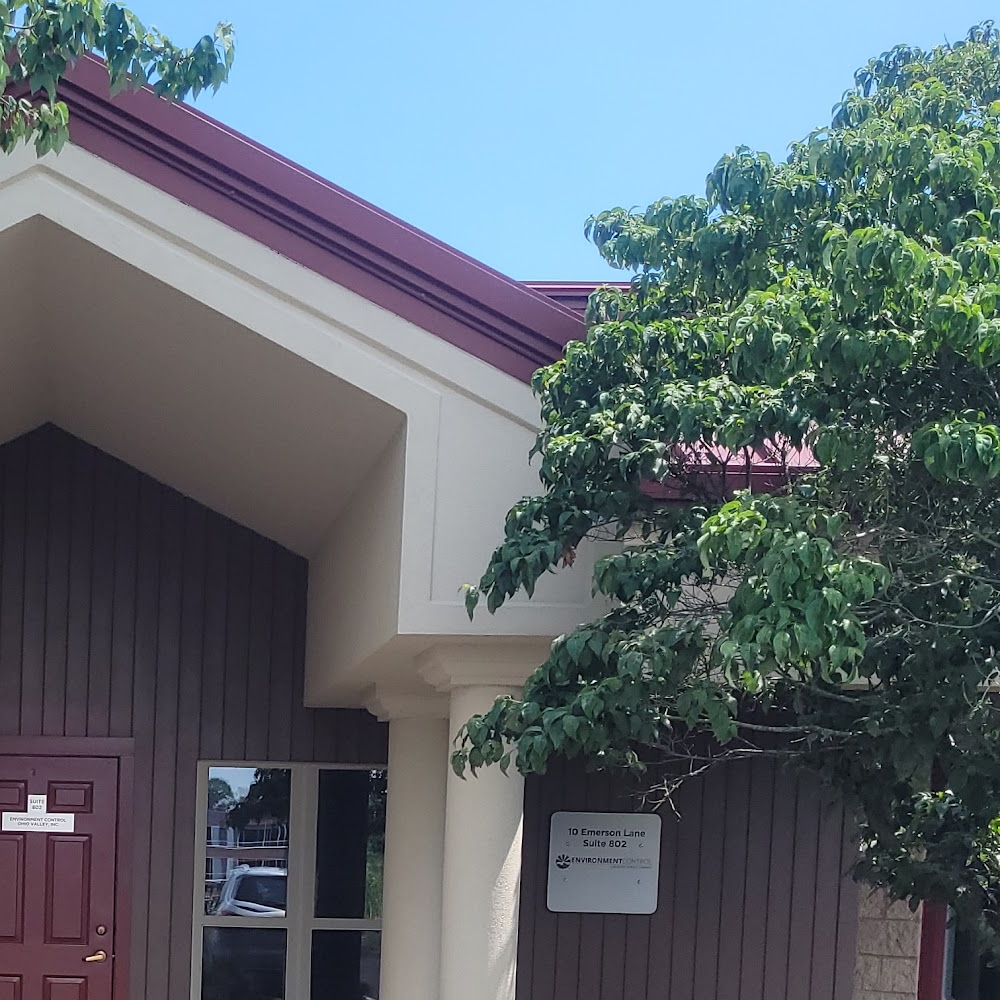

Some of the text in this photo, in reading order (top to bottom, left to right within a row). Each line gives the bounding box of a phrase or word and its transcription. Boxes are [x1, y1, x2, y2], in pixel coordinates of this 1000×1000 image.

[568, 828, 646, 838] 10 Emerson Lane
[608, 840, 627, 848] 802
